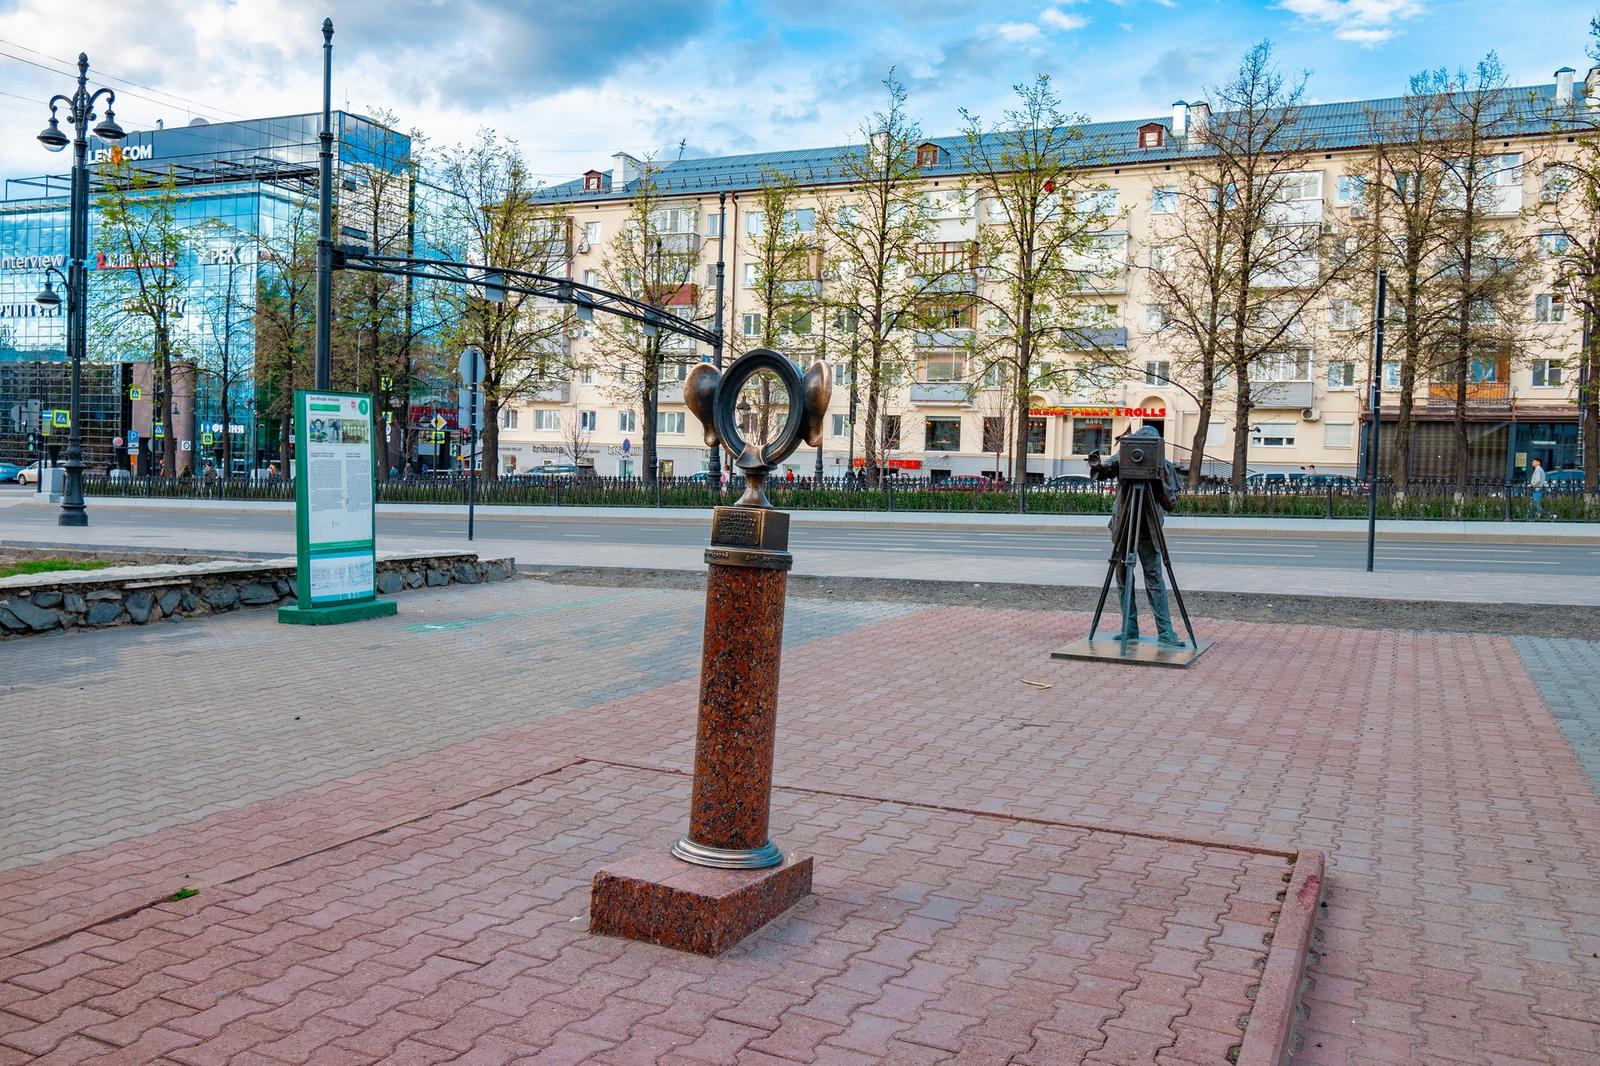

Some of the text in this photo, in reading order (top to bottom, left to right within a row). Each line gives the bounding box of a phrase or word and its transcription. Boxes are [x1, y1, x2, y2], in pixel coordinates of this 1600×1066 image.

[210, 247, 237, 264] РБК
[0, 255, 66, 268] nterview
[1125, 407, 1166, 417] ROLLS
[533, 444, 564, 453] tribuna
